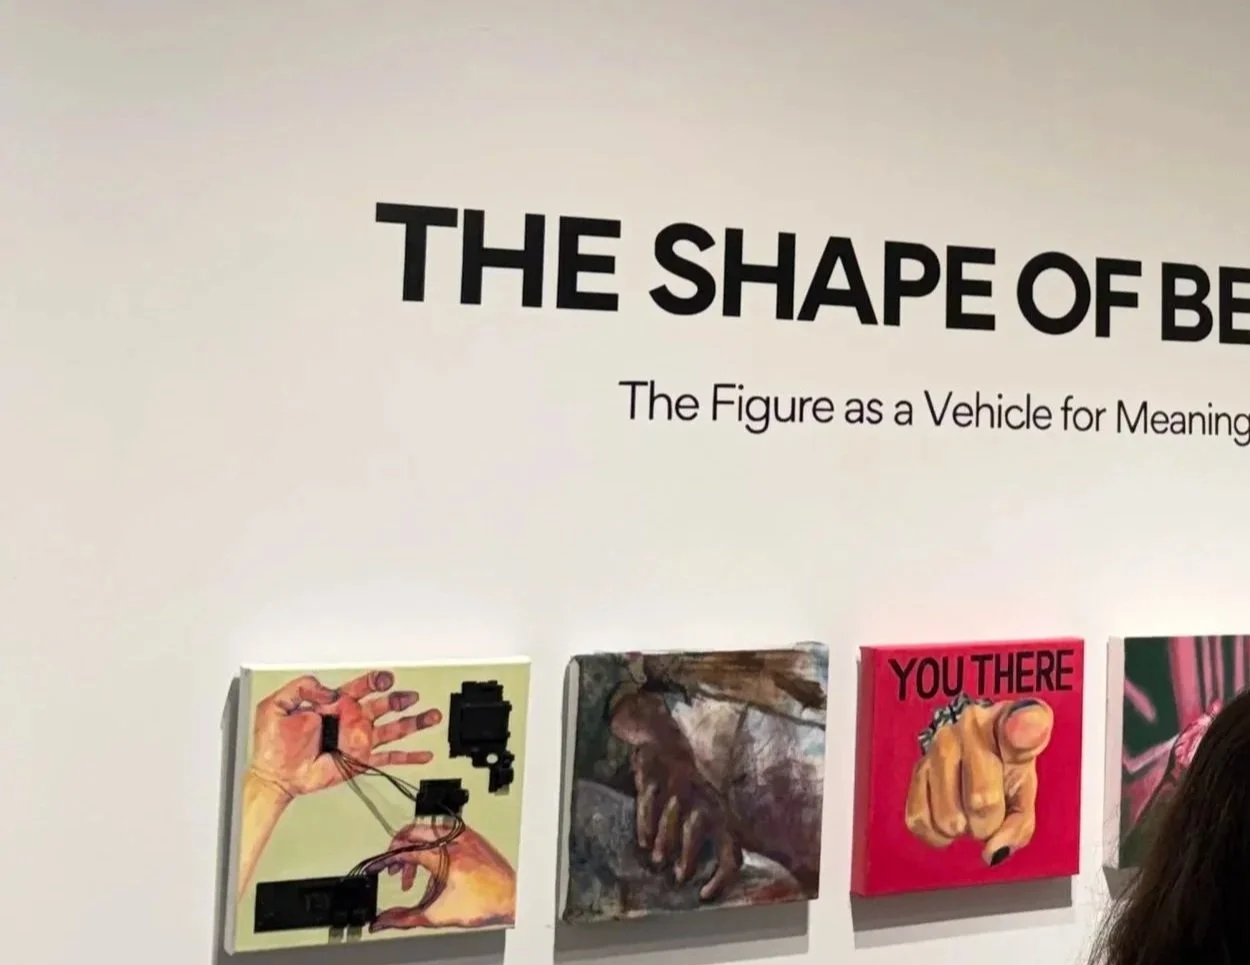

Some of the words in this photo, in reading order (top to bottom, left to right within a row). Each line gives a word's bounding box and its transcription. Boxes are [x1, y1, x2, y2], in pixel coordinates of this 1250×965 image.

[376, 203, 622, 311] THE
[648, 223, 996, 331] SHAPE
[1016, 252, 1142, 338] OF
[618, 379, 700, 421] The
[712, 383, 835, 435] Figure
[844, 398, 884, 425] as
[893, 400, 913, 426] a
[923, 389, 1053, 431] Vehicle
[1060, 395, 1107, 432] for
[888, 656, 965, 701] YOU
[971, 650, 1074, 696] THERE
